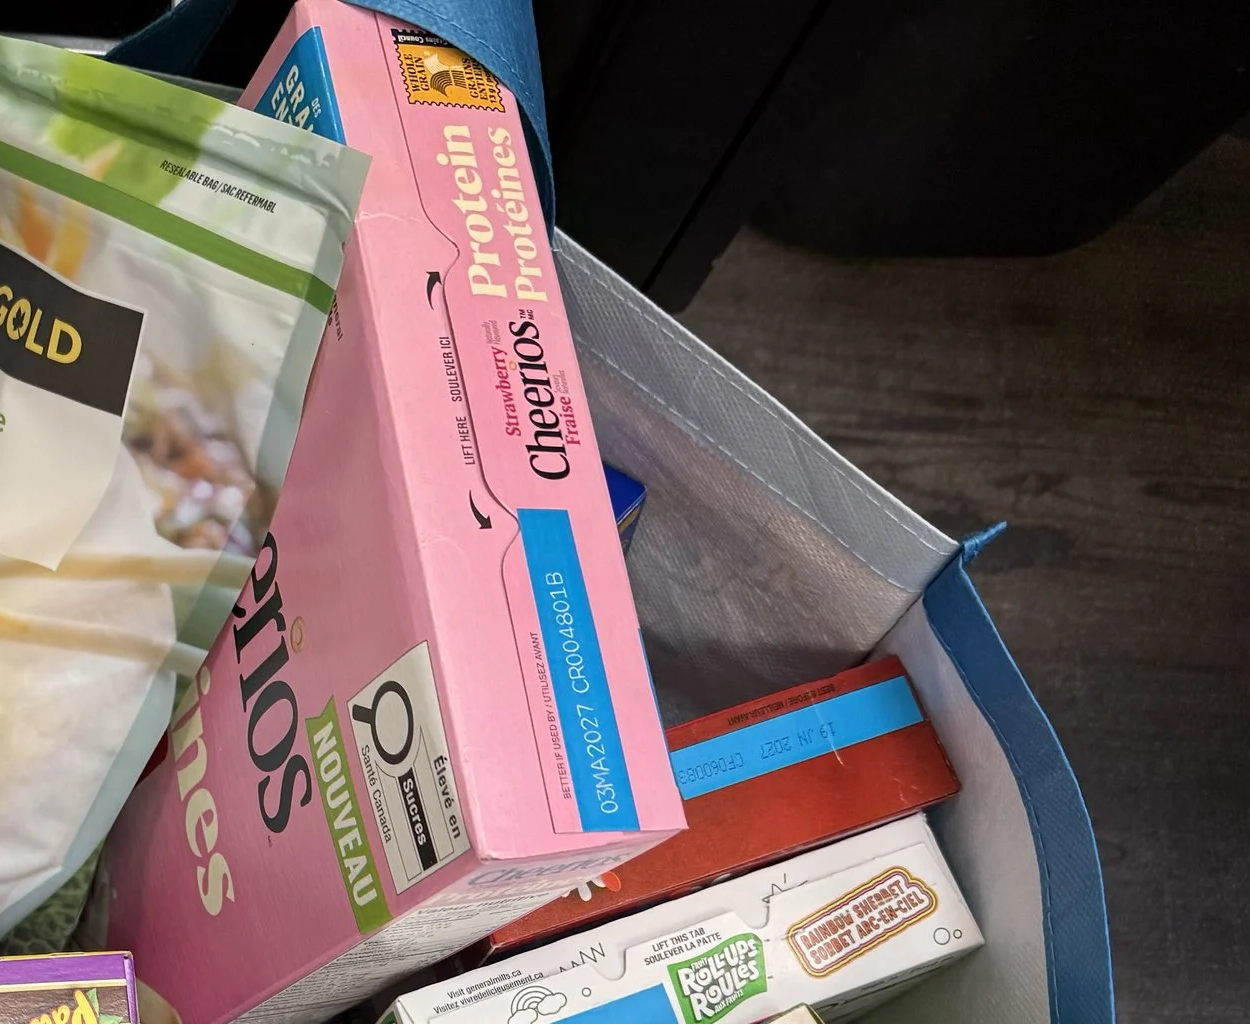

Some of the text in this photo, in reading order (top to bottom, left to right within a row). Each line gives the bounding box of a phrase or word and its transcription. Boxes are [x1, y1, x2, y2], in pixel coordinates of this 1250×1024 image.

[405, 52, 421, 93] WHOLE
[414, 54, 430, 91] GRAIN
[159, 159, 204, 185] RESEALABLE
[201, 175, 219, 192] BAG
[219, 182, 236, 198] SAC
[441, 119, 507, 301] Protein
[485, 125, 548, 304] Protéines
[438, 334, 462, 403] SOULEVER ICI
[492, 346, 520, 437] Strawberry
[510, 317, 567, 482] Cheerios
[455, 414, 475, 465] LIFT HERE
[558, 394, 580, 447] Fraise
[529, 631, 572, 799] BETTER IF USED BY UTILISEZ AVANT
[544, 570, 619, 814] 03MA2027 CR004801B
[757, 735, 792, 759] 2027
[795, 727, 815, 746] JN
[817, 720, 836, 739] 19
[308, 720, 377, 907] NOUVEAU
[357, 744, 395, 843] Santé Canada
[400, 777, 429, 846] Sucres
[430, 755, 462, 839] Élevé en
[798, 877, 906, 952] RAINBOW SHERBET
[809, 888, 926, 966] SORBET ARC-EN-CIEL
[433, 998, 460, 1016] Visitez
[446, 967, 523, 1000] Visit generalmills.ca
